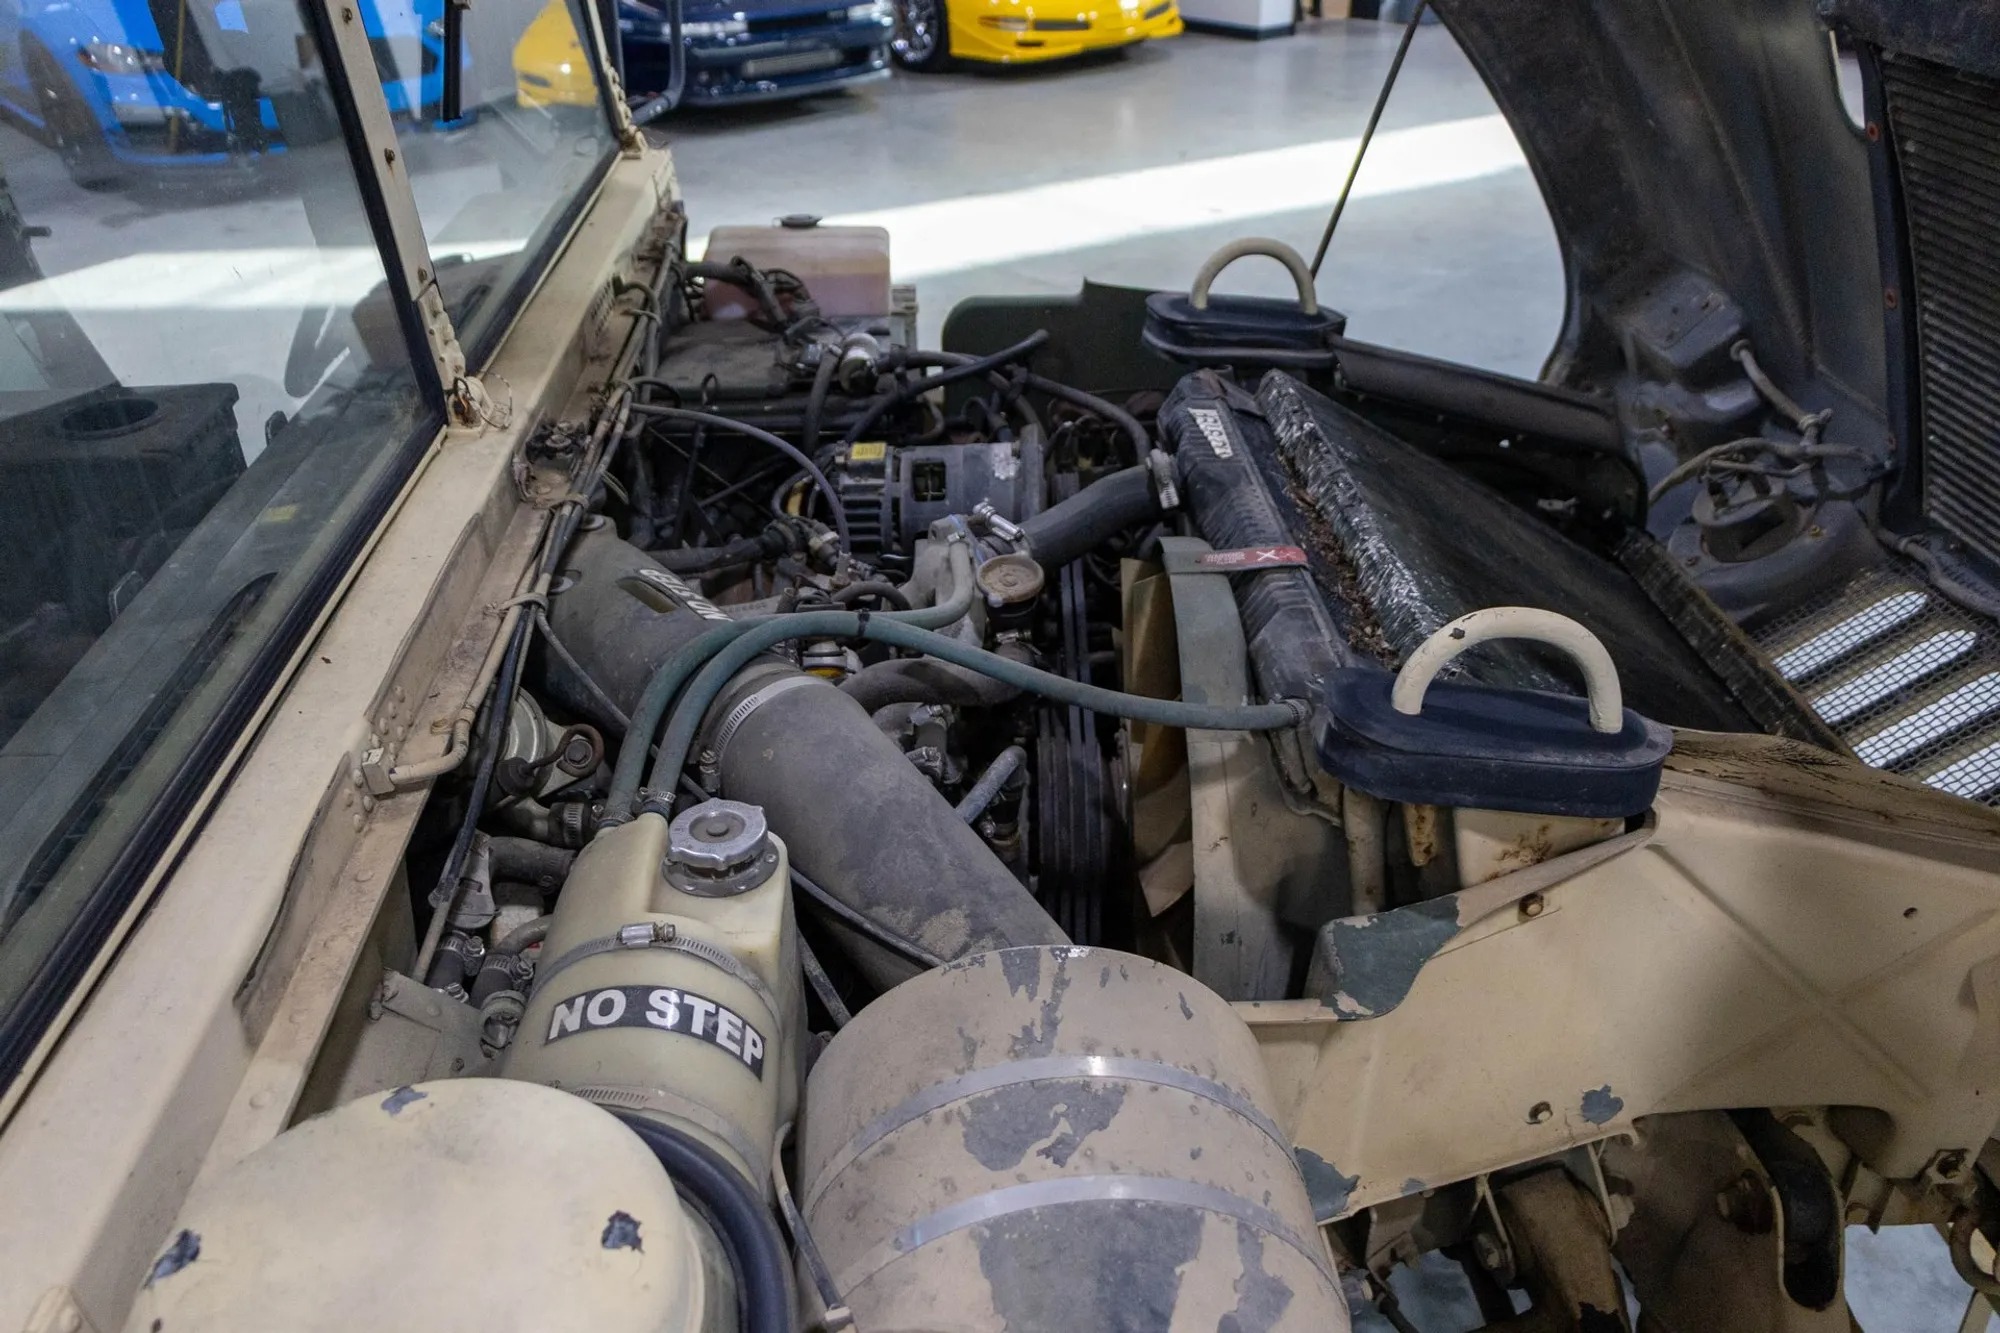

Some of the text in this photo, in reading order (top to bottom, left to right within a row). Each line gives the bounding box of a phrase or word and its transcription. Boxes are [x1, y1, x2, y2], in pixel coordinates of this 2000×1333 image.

[639, 569, 704, 600] STEP
[687, 600, 734, 622] NO
[548, 989, 763, 1066] NO STEP
